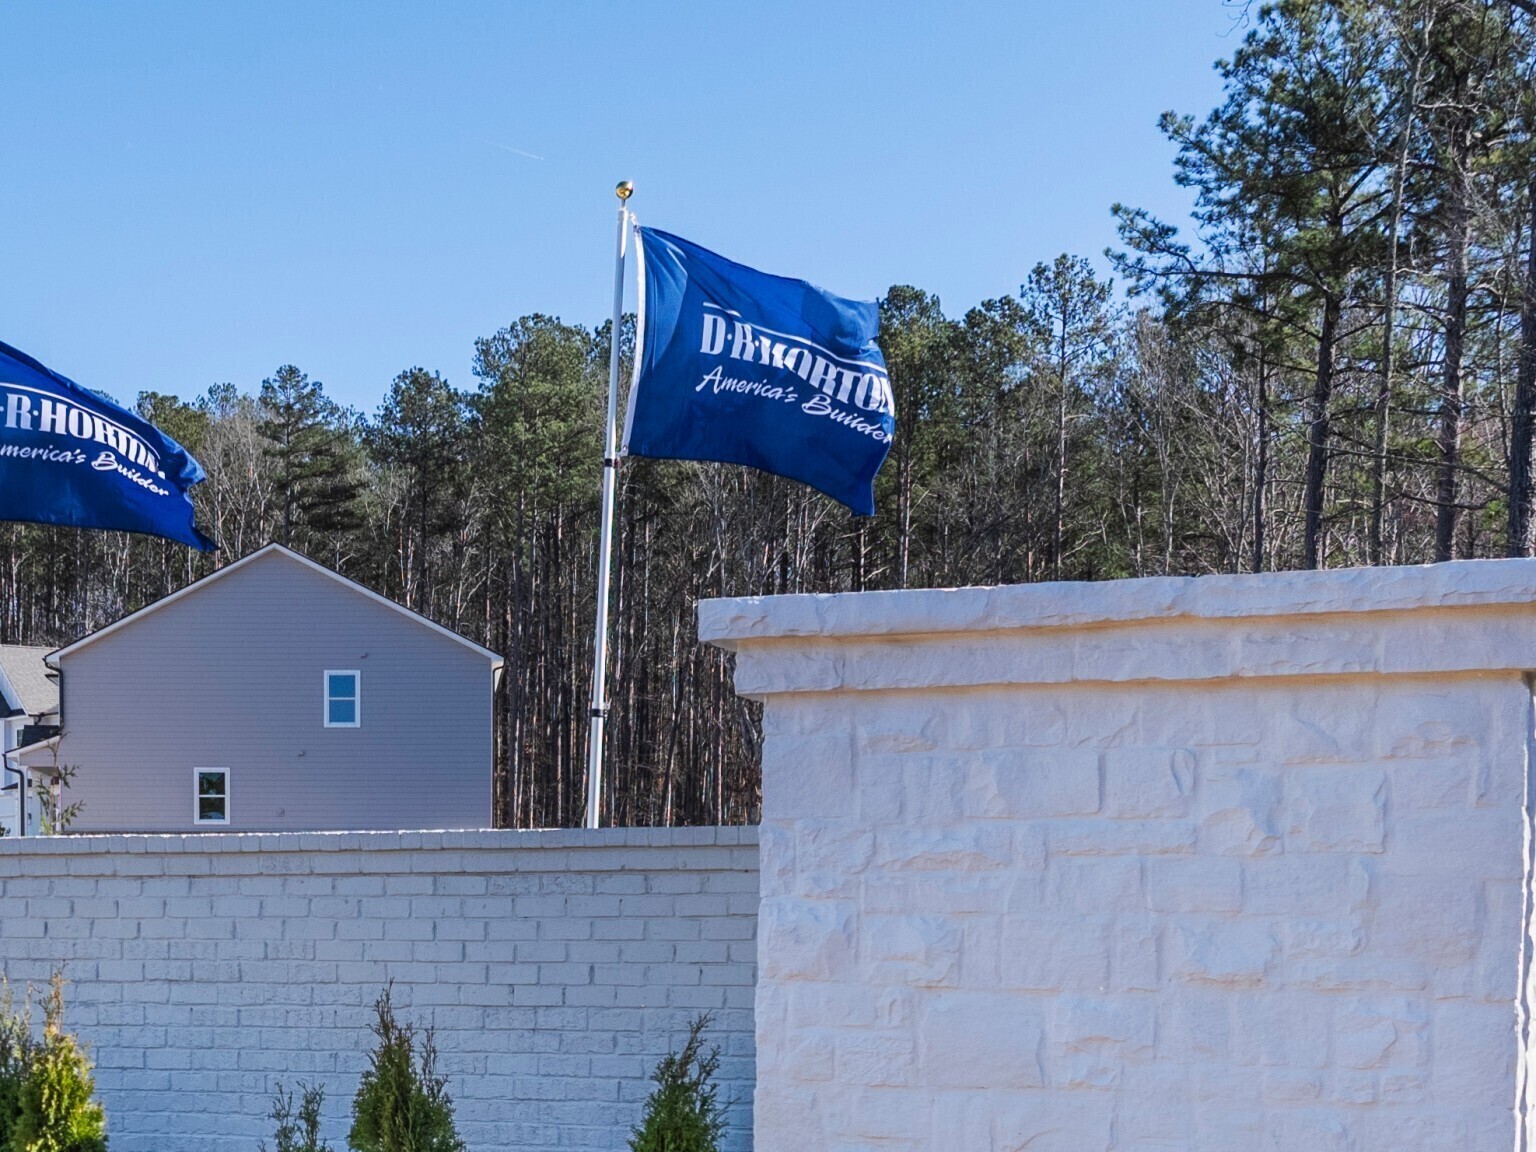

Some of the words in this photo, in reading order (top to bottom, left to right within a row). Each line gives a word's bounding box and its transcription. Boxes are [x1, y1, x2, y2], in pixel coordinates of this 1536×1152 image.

[695, 365, 798, 403] America's
[801, 394, 892, 444] Builder
[90, 451, 170, 496] Builder
